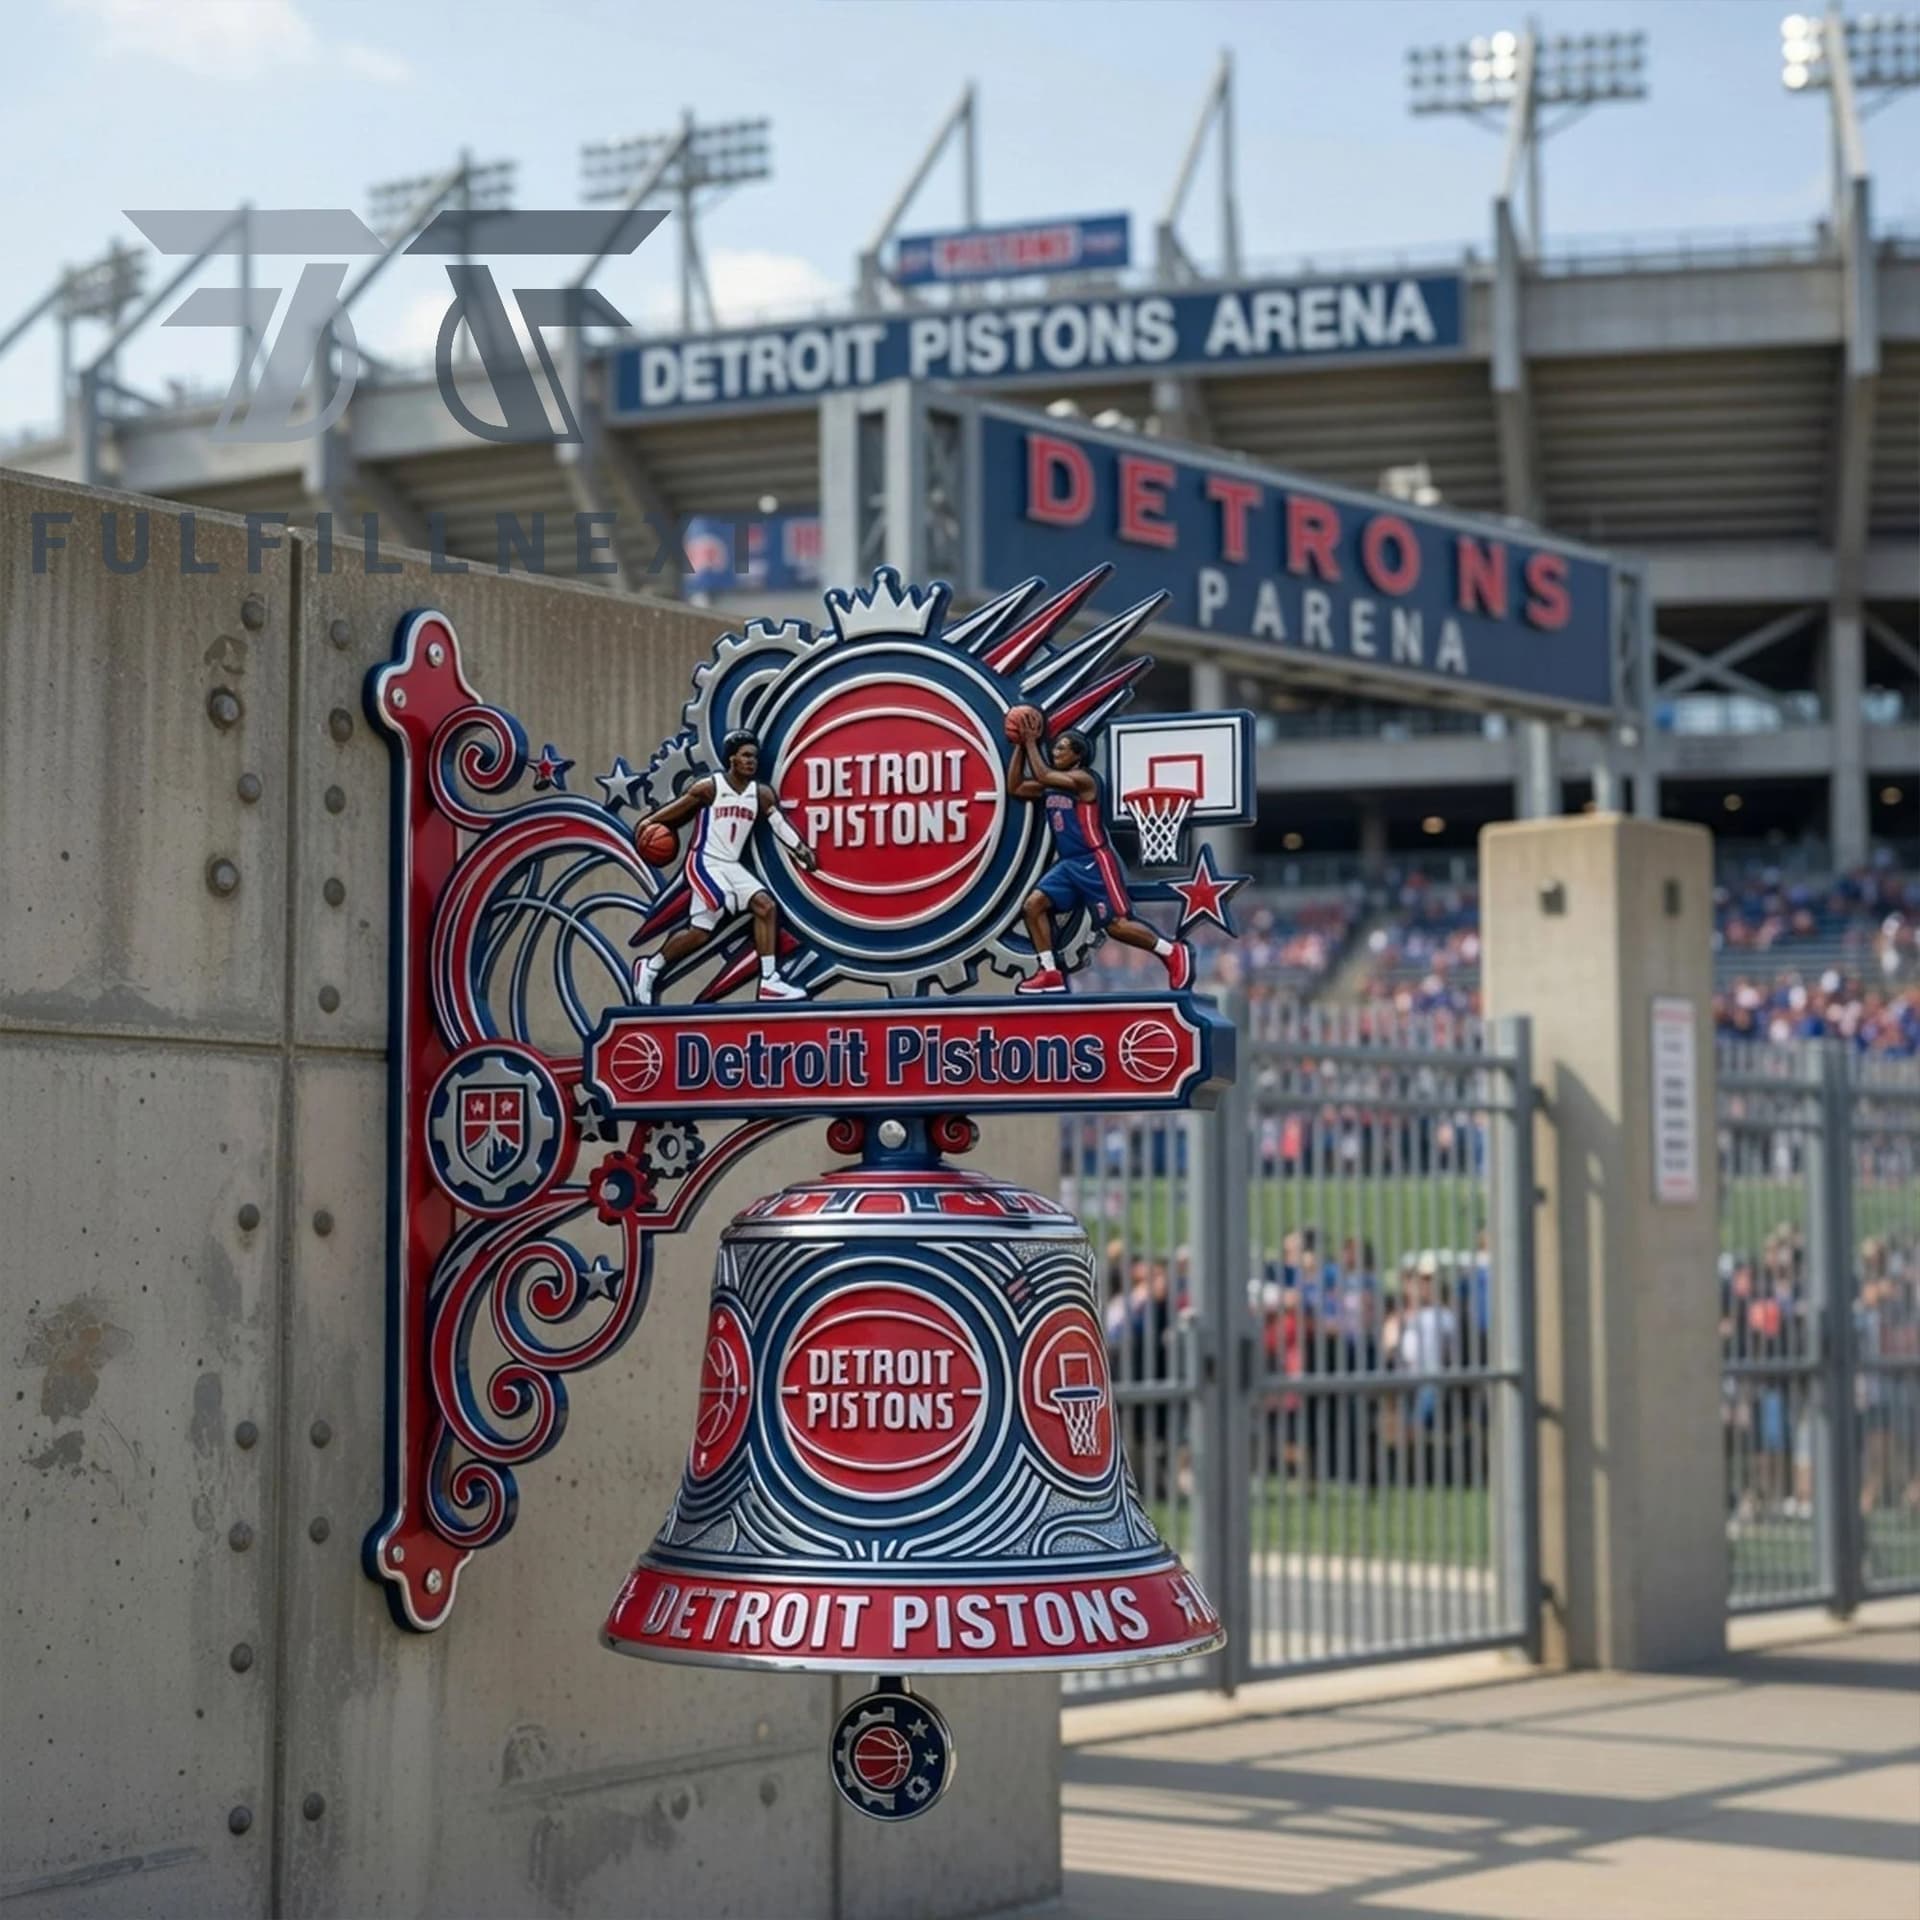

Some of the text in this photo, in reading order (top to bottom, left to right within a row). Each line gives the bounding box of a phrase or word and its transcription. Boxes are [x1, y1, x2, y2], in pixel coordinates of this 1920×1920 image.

[641, 281, 1435, 404] DETROIT PISTONS ARENA
[1198, 570, 1468, 674] PARENA
[805, 749, 966, 799] DETROIT
[807, 801, 968, 848] PISTONS
[675, 1026, 1106, 1090] Detroit Pistons
[808, 1349, 954, 1386] DETROIT
[807, 1392, 955, 1431] PISTONS
[642, 1584, 871, 1649] DETROIT
[891, 1588, 1149, 1650] PISTONS
